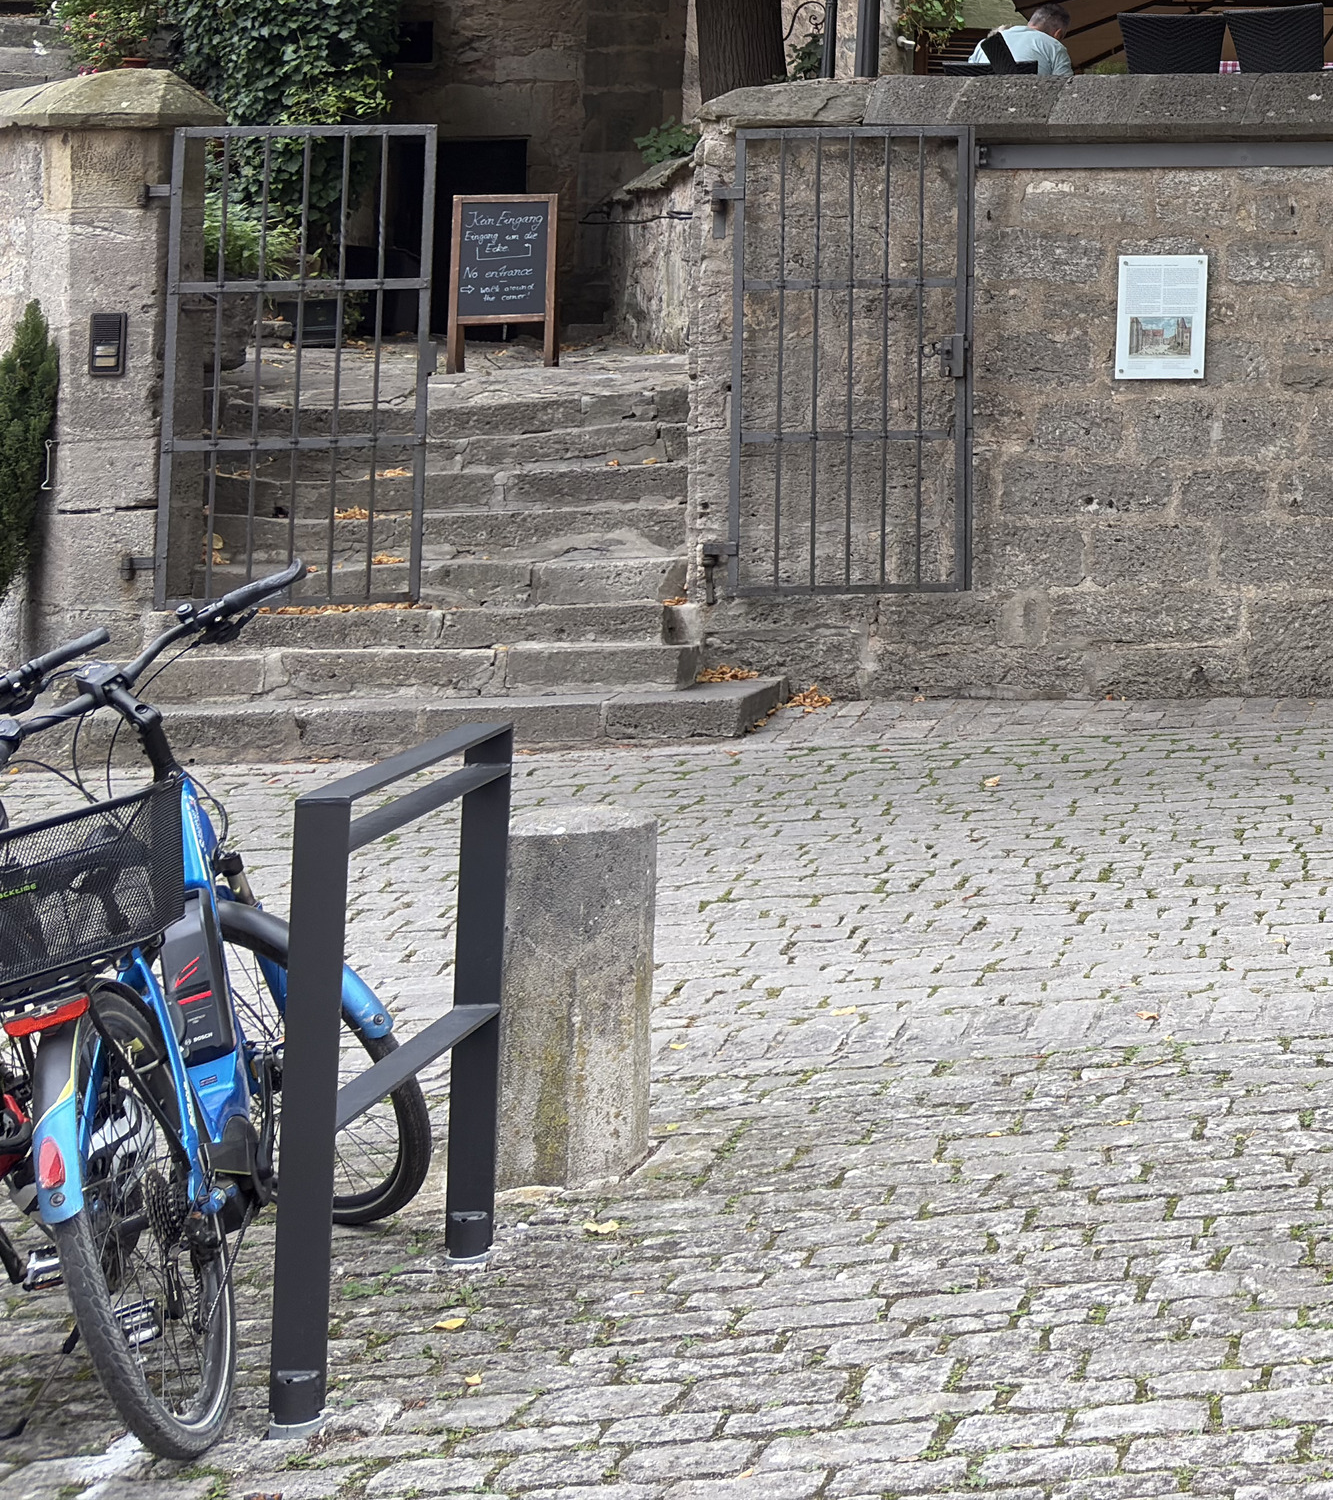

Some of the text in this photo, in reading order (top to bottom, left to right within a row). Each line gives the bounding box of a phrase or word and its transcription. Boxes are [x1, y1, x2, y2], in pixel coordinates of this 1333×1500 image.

[465, 210, 544, 231] Kein Eingang
[464, 230, 499, 245] Eingang
[523, 231, 539, 240] die
[463, 264, 534, 279] No entrance
[480, 282, 536, 294] walk around
[483, 294, 497, 302] the
[193, 1031, 214, 1044] BOSCH
